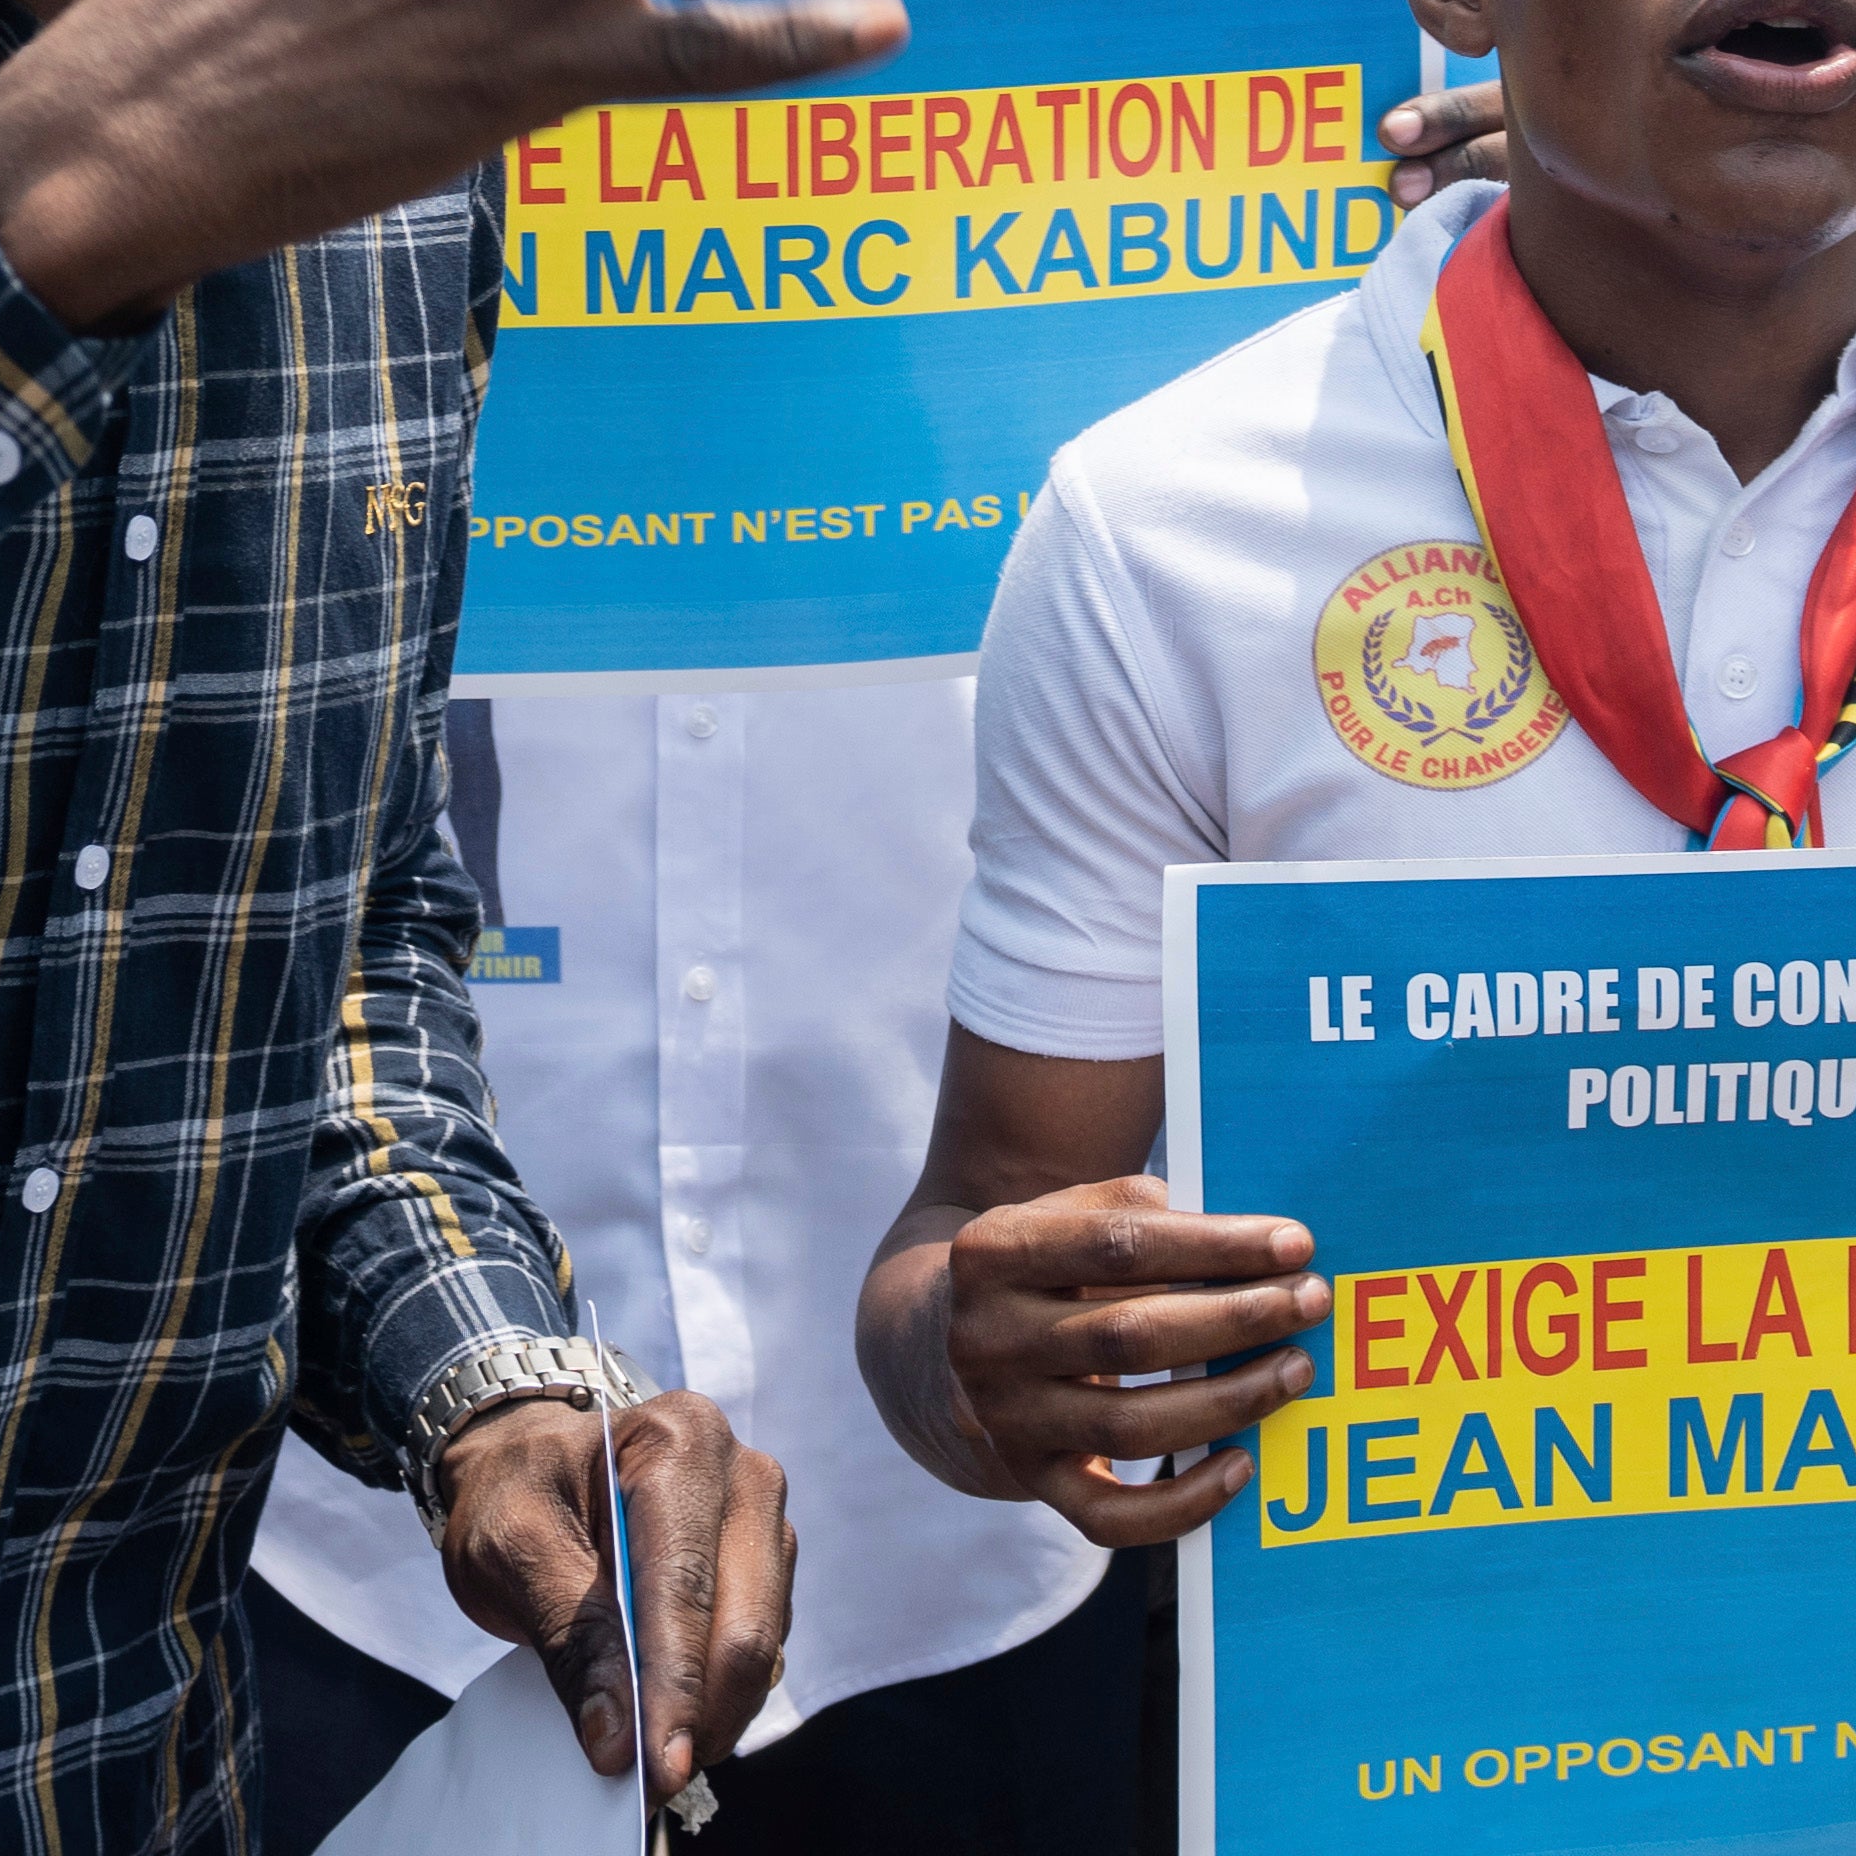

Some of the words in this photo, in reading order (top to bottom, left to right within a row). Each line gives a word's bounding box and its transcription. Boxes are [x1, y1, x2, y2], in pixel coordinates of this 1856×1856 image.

[597, 108, 707, 204] LA
[734, 79, 1216, 200] LIBERATION
[1247, 70, 1346, 168] DE
[584, 218, 912, 315] MARC
[954, 184, 1396, 300] KABUND
[732, 502, 886, 544] N’EST
[900, 494, 1004, 535] PAS
[1342, 547, 1503, 614] ALLIAN
[1405, 586, 1472, 609] A.Ch
[1321, 670, 1375, 751] POUR
[1373, 742, 1412, 774] LE
[1420, 693, 1569, 780] CHANGEME
[1308, 975, 1376, 1042] LE
[1405, 967, 1621, 1042] CADRE
[1636, 964, 1717, 1032] DE
[1354, 1255, 1648, 1391] EXIGE
[1686, 1247, 1814, 1365] LA
[1265, 1401, 1613, 1533] JEAN
[1357, 1754, 1443, 1801] UN
[1462, 1724, 1818, 1789] OPPOSANT
